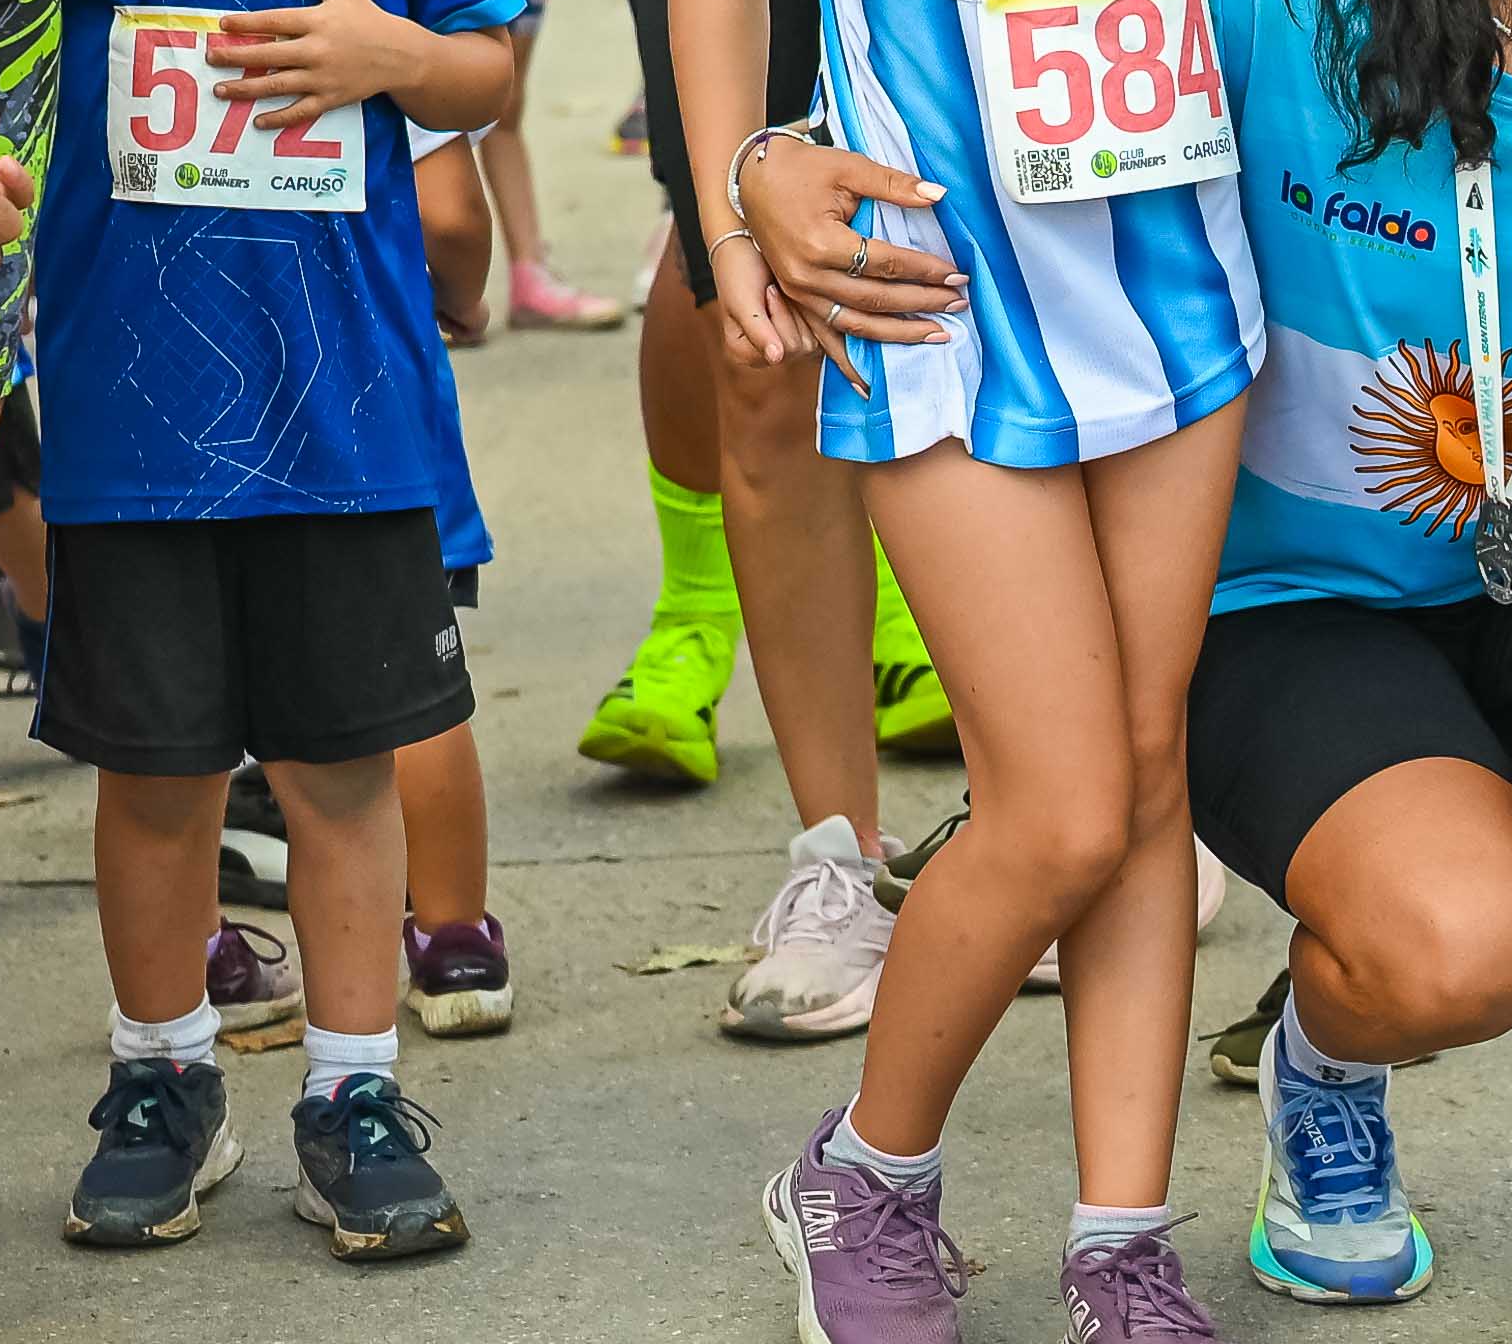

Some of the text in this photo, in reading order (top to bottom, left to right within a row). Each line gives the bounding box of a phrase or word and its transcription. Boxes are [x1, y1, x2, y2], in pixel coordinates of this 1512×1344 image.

[1119, 148, 1145, 161] CLUB
[1183, 137, 1231, 162] CARUSO
[202, 168, 344, 193] CLUB CARUSO
[1280, 170, 1438, 253] la falda
